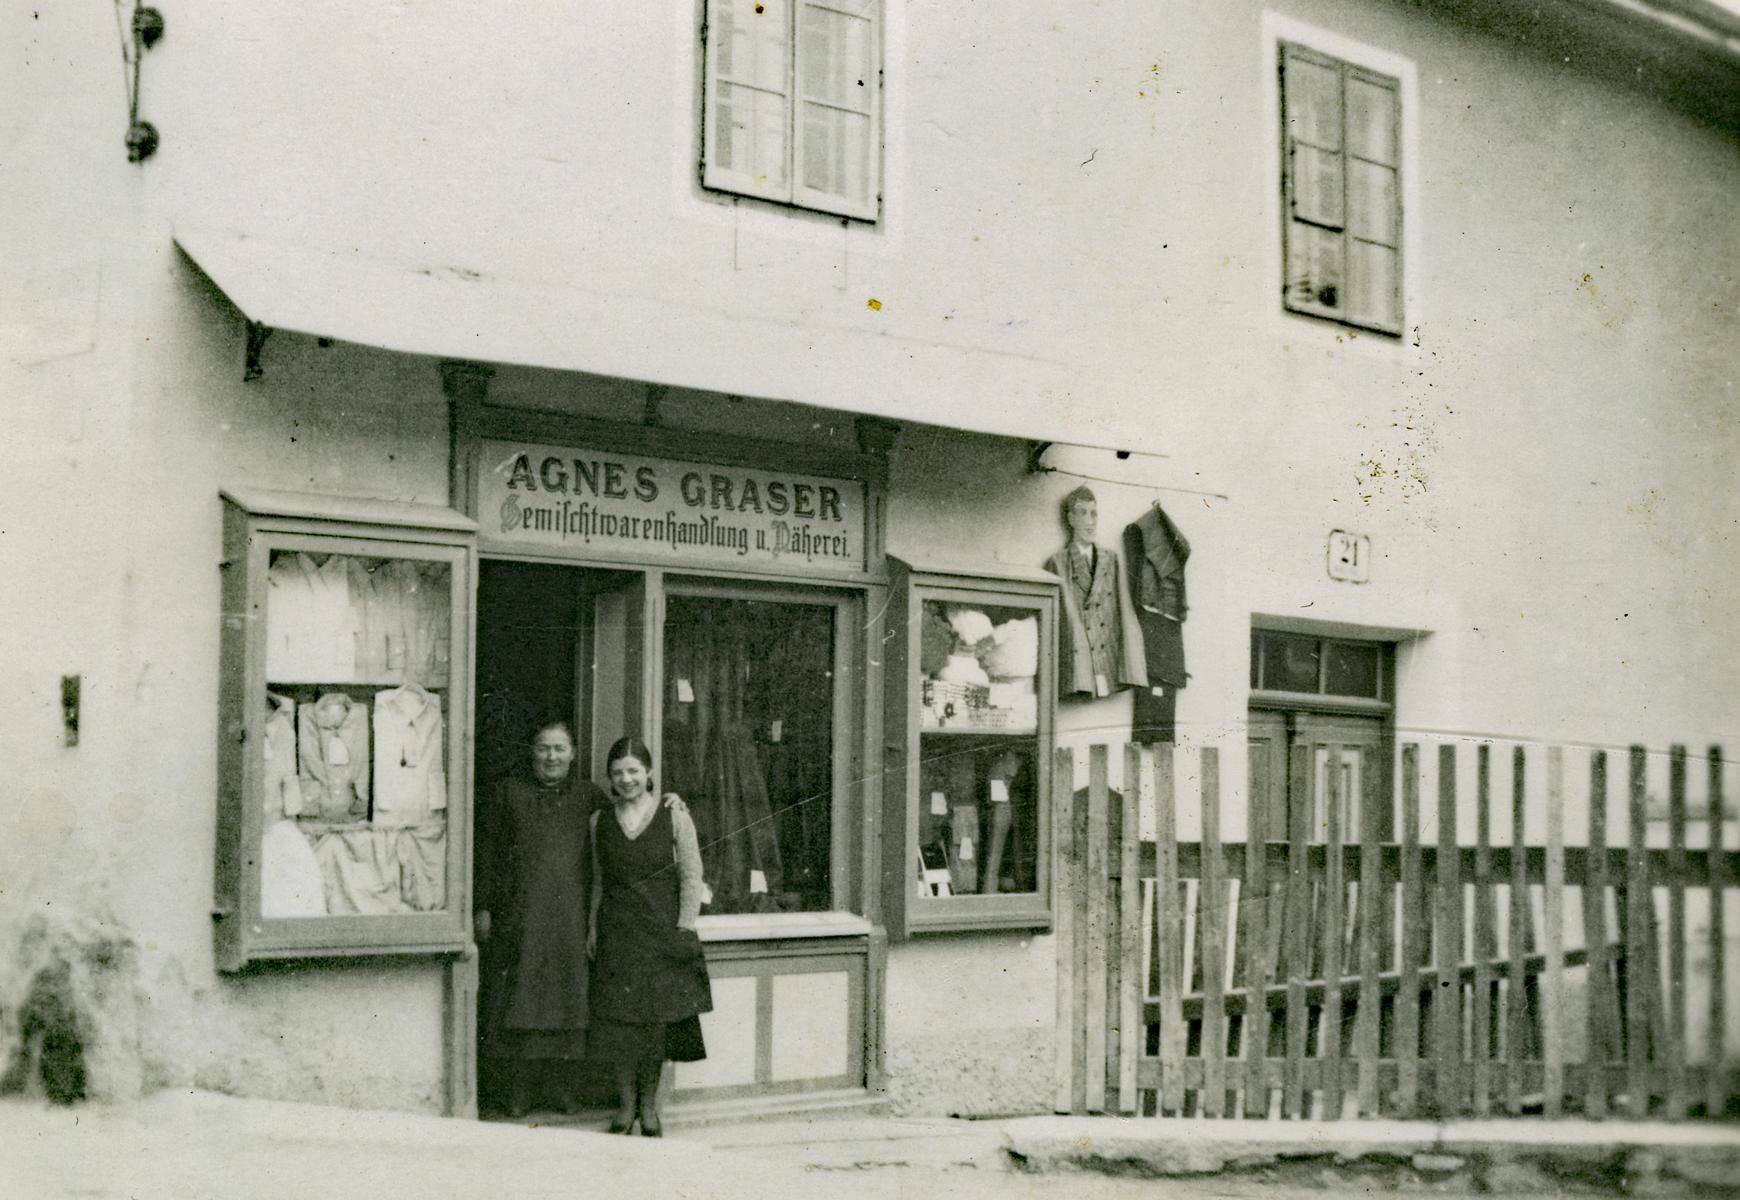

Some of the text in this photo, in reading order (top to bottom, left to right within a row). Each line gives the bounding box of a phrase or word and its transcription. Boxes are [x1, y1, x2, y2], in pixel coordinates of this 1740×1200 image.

[507, 454, 843, 522] AGNES GRASER
[756, 530, 770, 551] u.
[1340, 538, 1358, 567] 21
